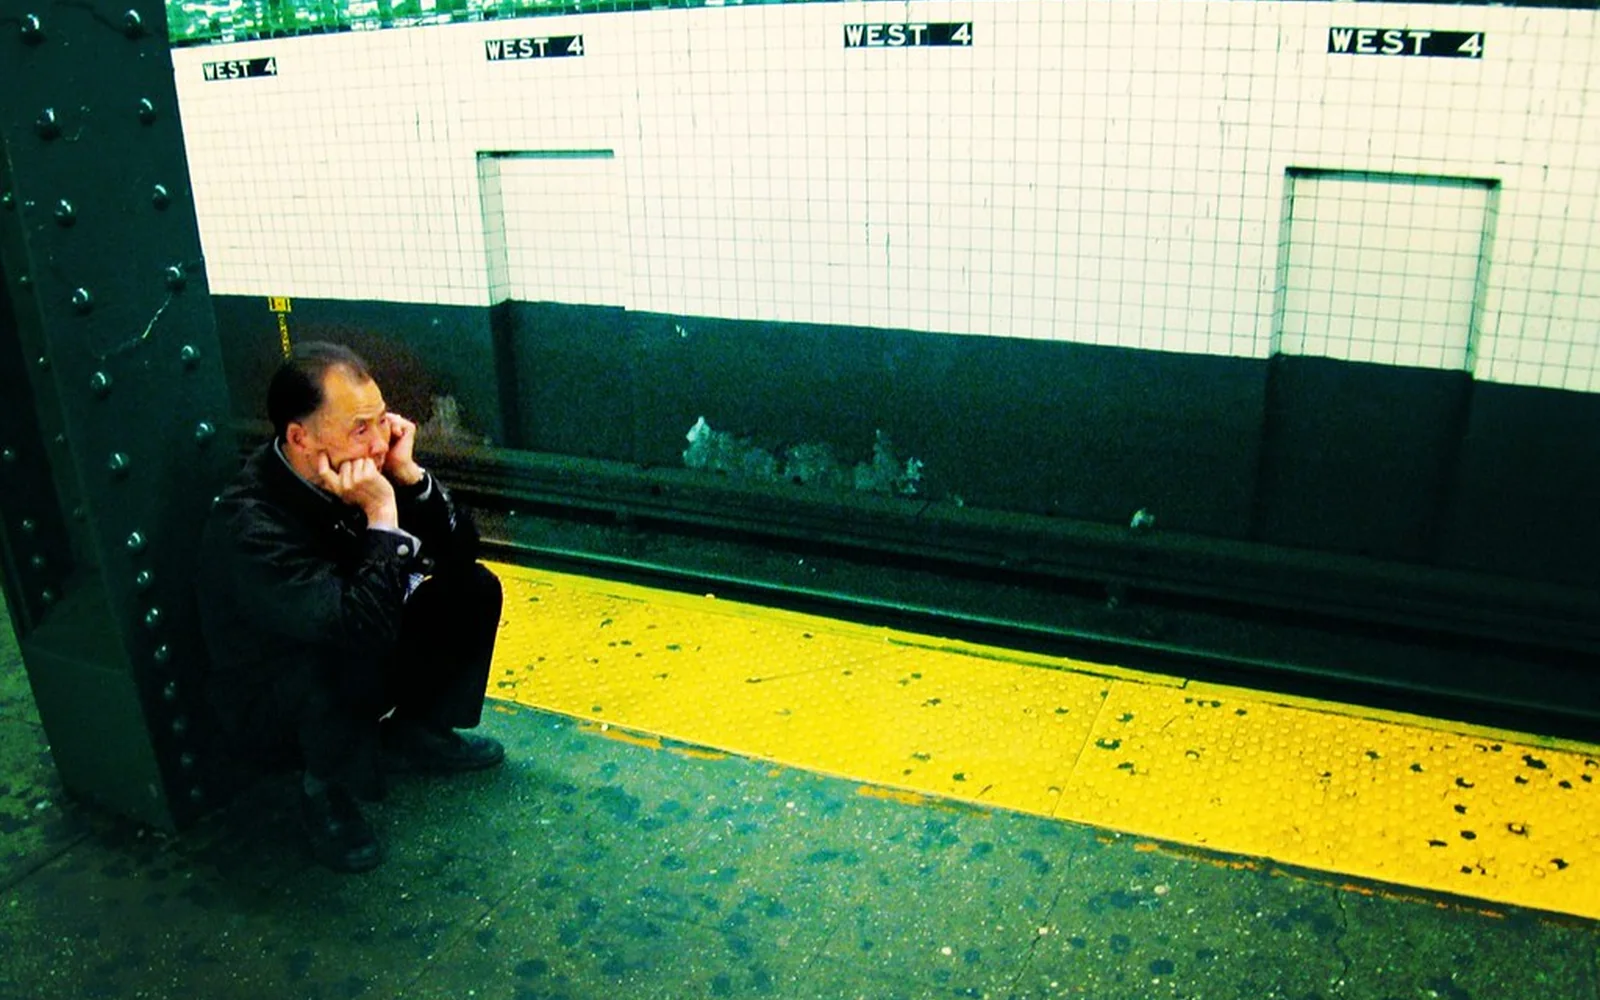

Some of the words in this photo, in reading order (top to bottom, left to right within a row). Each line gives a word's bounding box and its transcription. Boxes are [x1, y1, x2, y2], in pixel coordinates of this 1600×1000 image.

[846, 24, 928, 47] WEST
[951, 23, 971, 46] 4
[1331, 29, 1432, 55] WEST
[1457, 33, 1482, 57] 4
[486, 38, 549, 60] WEST
[567, 35, 583, 55] 4
[203, 61, 251, 80] WEST
[264, 57, 276, 75] 4
